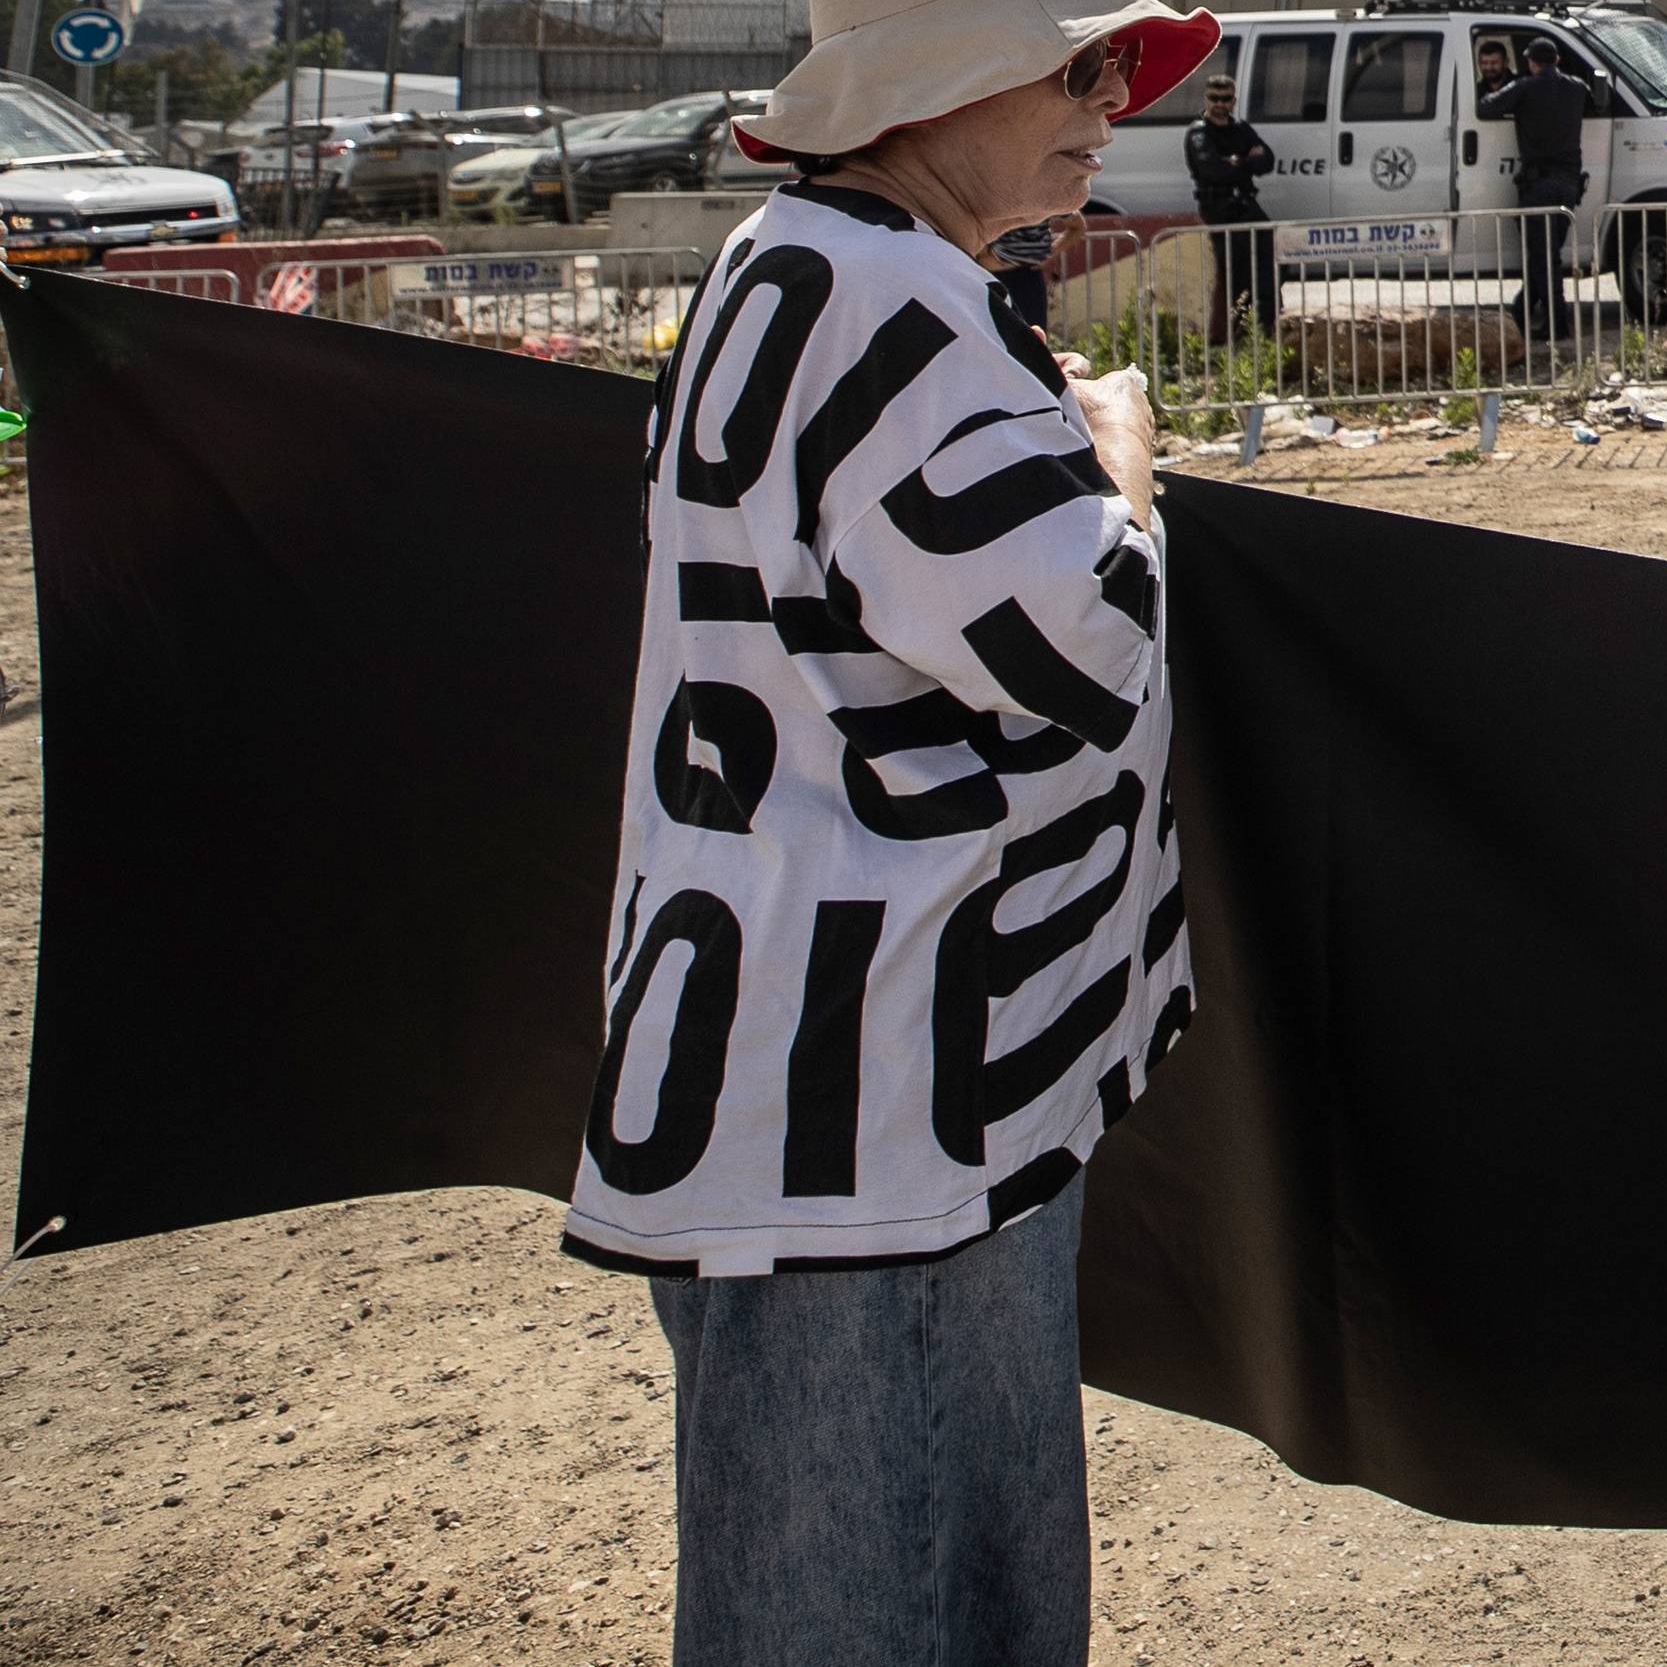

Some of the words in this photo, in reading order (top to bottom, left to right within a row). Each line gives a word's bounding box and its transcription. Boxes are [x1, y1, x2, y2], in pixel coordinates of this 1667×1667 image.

[1277, 158, 1326, 175] LICE
[1308, 226, 1359, 245] במות
[1368, 223, 1415, 243] קשת
